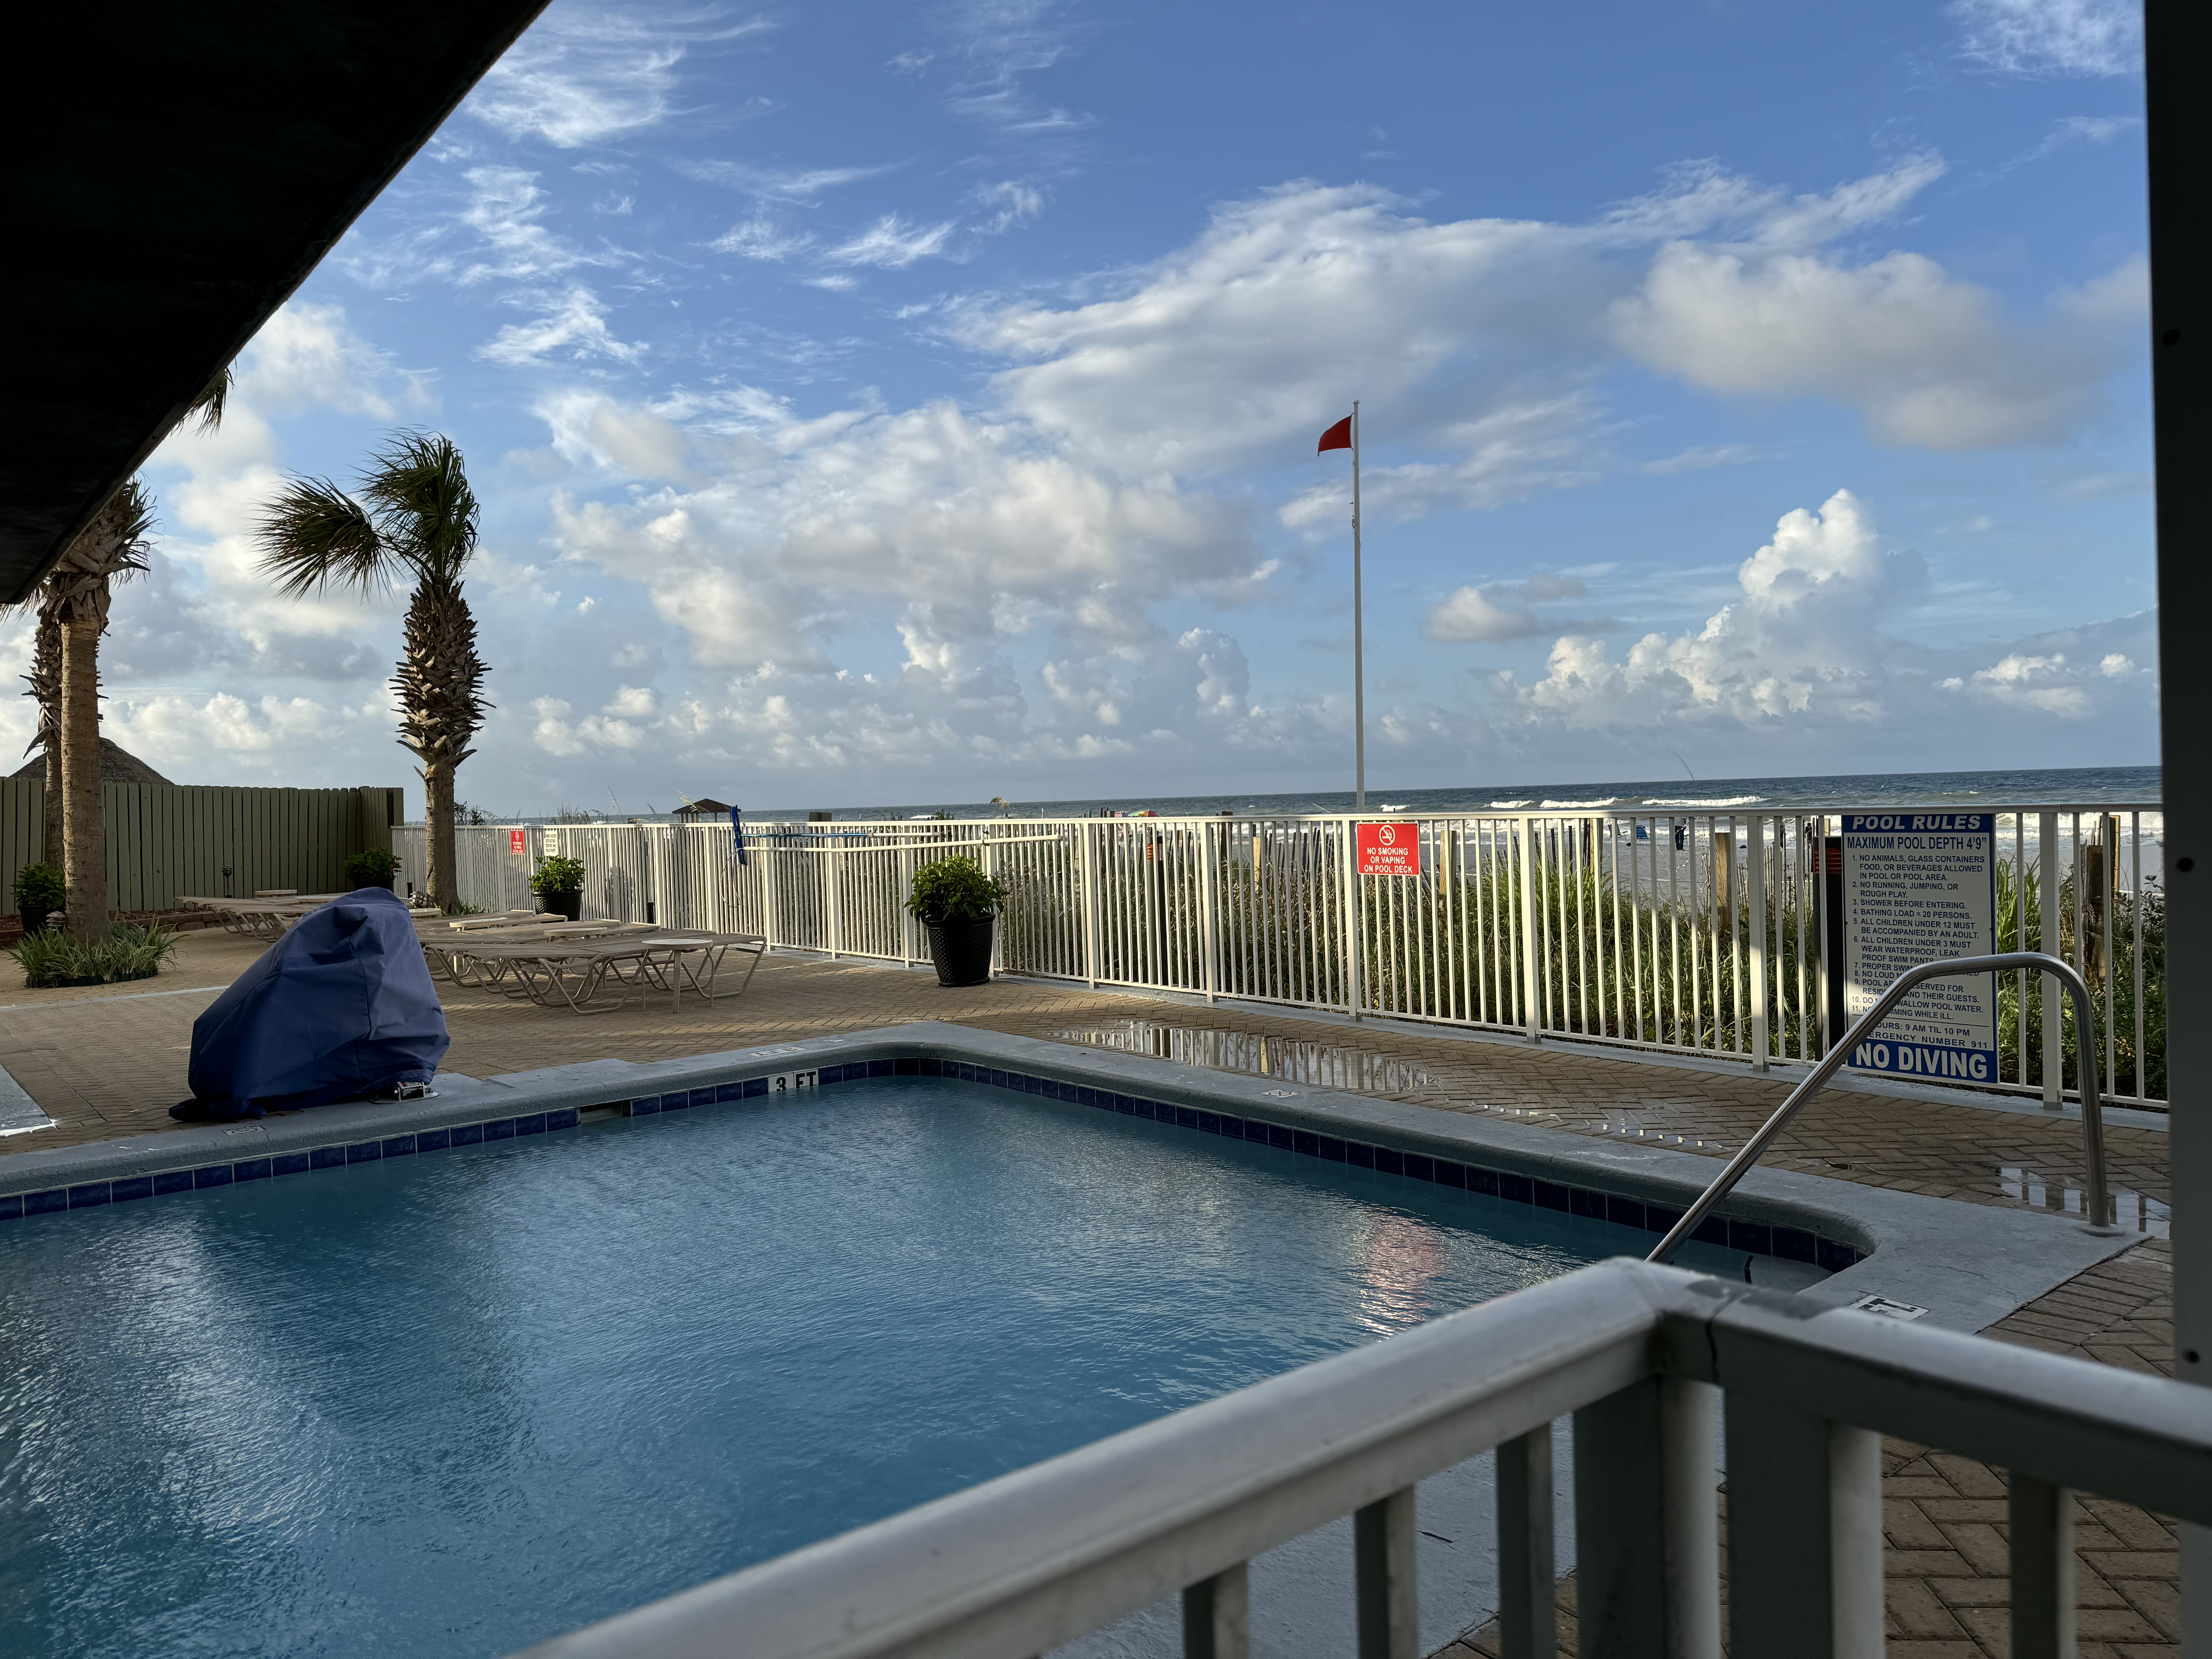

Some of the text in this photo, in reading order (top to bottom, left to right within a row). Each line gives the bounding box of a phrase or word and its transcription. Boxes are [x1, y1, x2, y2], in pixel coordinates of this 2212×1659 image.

[1853, 815, 1980, 830] POOL RULES
[1847, 837, 1894, 848] MAXIMUM
[1898, 837, 1926, 849] POOL
[1929, 837, 1963, 849] DEPTH
[1910, 883, 1945, 891] JUMPING,
[1873, 927, 1926, 936] ACCOMPANIED
[1885, 946, 1937, 956] WATERPROOF,
[1946, 994, 1979, 1003] GUESTS.
[1954, 1004, 1983, 1013] WATER.
[1915, 1010, 1938, 1018] WHILE
[1922, 1036, 1965, 1046] NUMBER
[1856, 1043, 1987, 1079] NO DIVING
[776, 1071, 816, 1091] 3 FT
